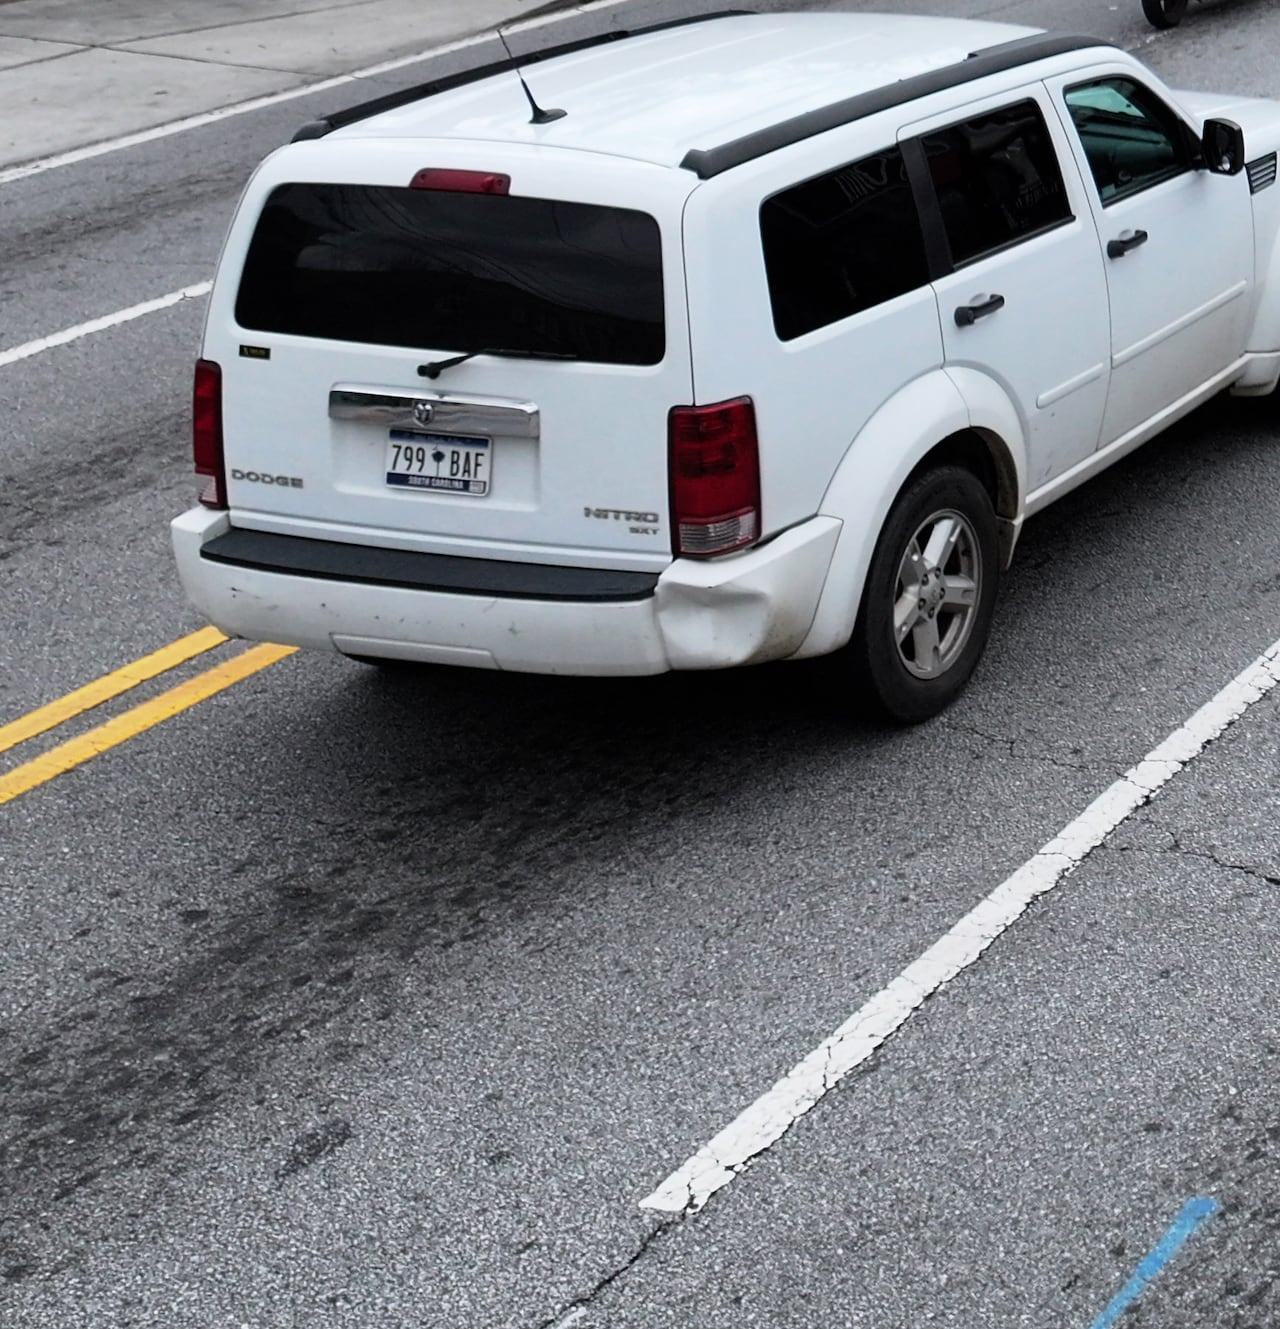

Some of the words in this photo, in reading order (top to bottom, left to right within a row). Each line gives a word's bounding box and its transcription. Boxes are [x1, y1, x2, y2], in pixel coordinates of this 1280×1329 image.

[391, 444, 426, 473] 799
[450, 450, 486, 480] BAF
[231, 468, 304, 489] DODGE
[583, 506, 660, 524] NITRO
[629, 526, 660, 536] SXT
